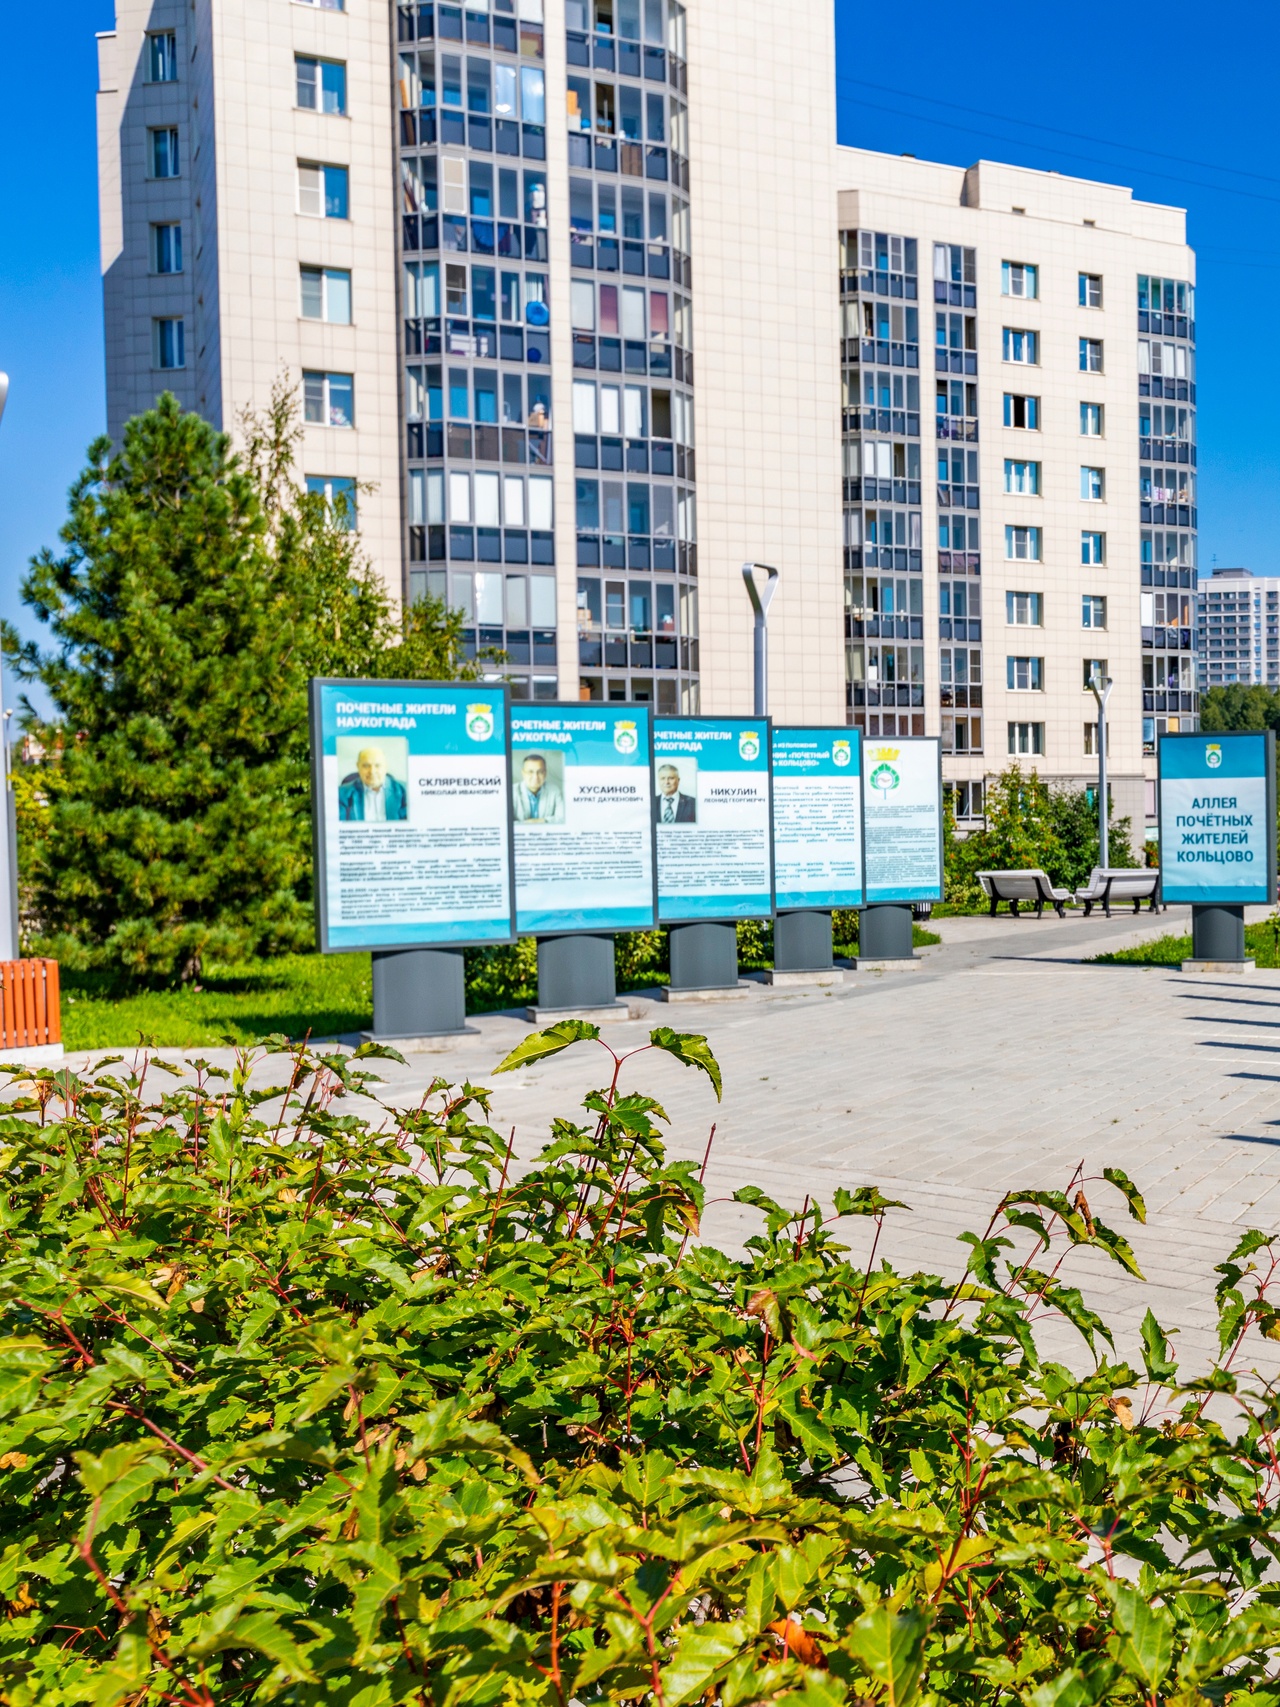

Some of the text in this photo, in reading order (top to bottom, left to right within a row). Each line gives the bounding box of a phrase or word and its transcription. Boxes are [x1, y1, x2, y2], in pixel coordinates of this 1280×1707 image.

[336, 702, 456, 715] ПОЧЕТНЫЕ ЖИТЕЛИ
[336, 716, 417, 730] НАУКОГРАДА
[511, 719, 606, 730] ОЧЕТНЫЕ ЖИТЕЛИ
[512, 732, 572, 744] АУКОГРАДА
[654, 731, 732, 740] ЧЕТНЫЕ ЖИТЕЛИ
[654, 741, 703, 752] УКОГРАДА
[788, 750, 830, 759] «ПОЧЕТНЫЙ
[778, 759, 819, 767] КОЛЬЦОВО»
[419, 776, 501, 786] СКЛЯРЕВСКИЙ
[421, 788, 457, 796] НИКОЛАЙ
[579, 786, 636, 794] ХУСАИНОВ
[710, 788, 757, 796] НИКУЛИН
[1192, 797, 1237, 809] АЛЛЕЯ
[1176, 812, 1253, 827] ПОЧЁТНЫХ
[1181, 829, 1248, 845] ЖИТЕЛЕЙ
[1177, 850, 1254, 864] КОЛЬЦОВО
